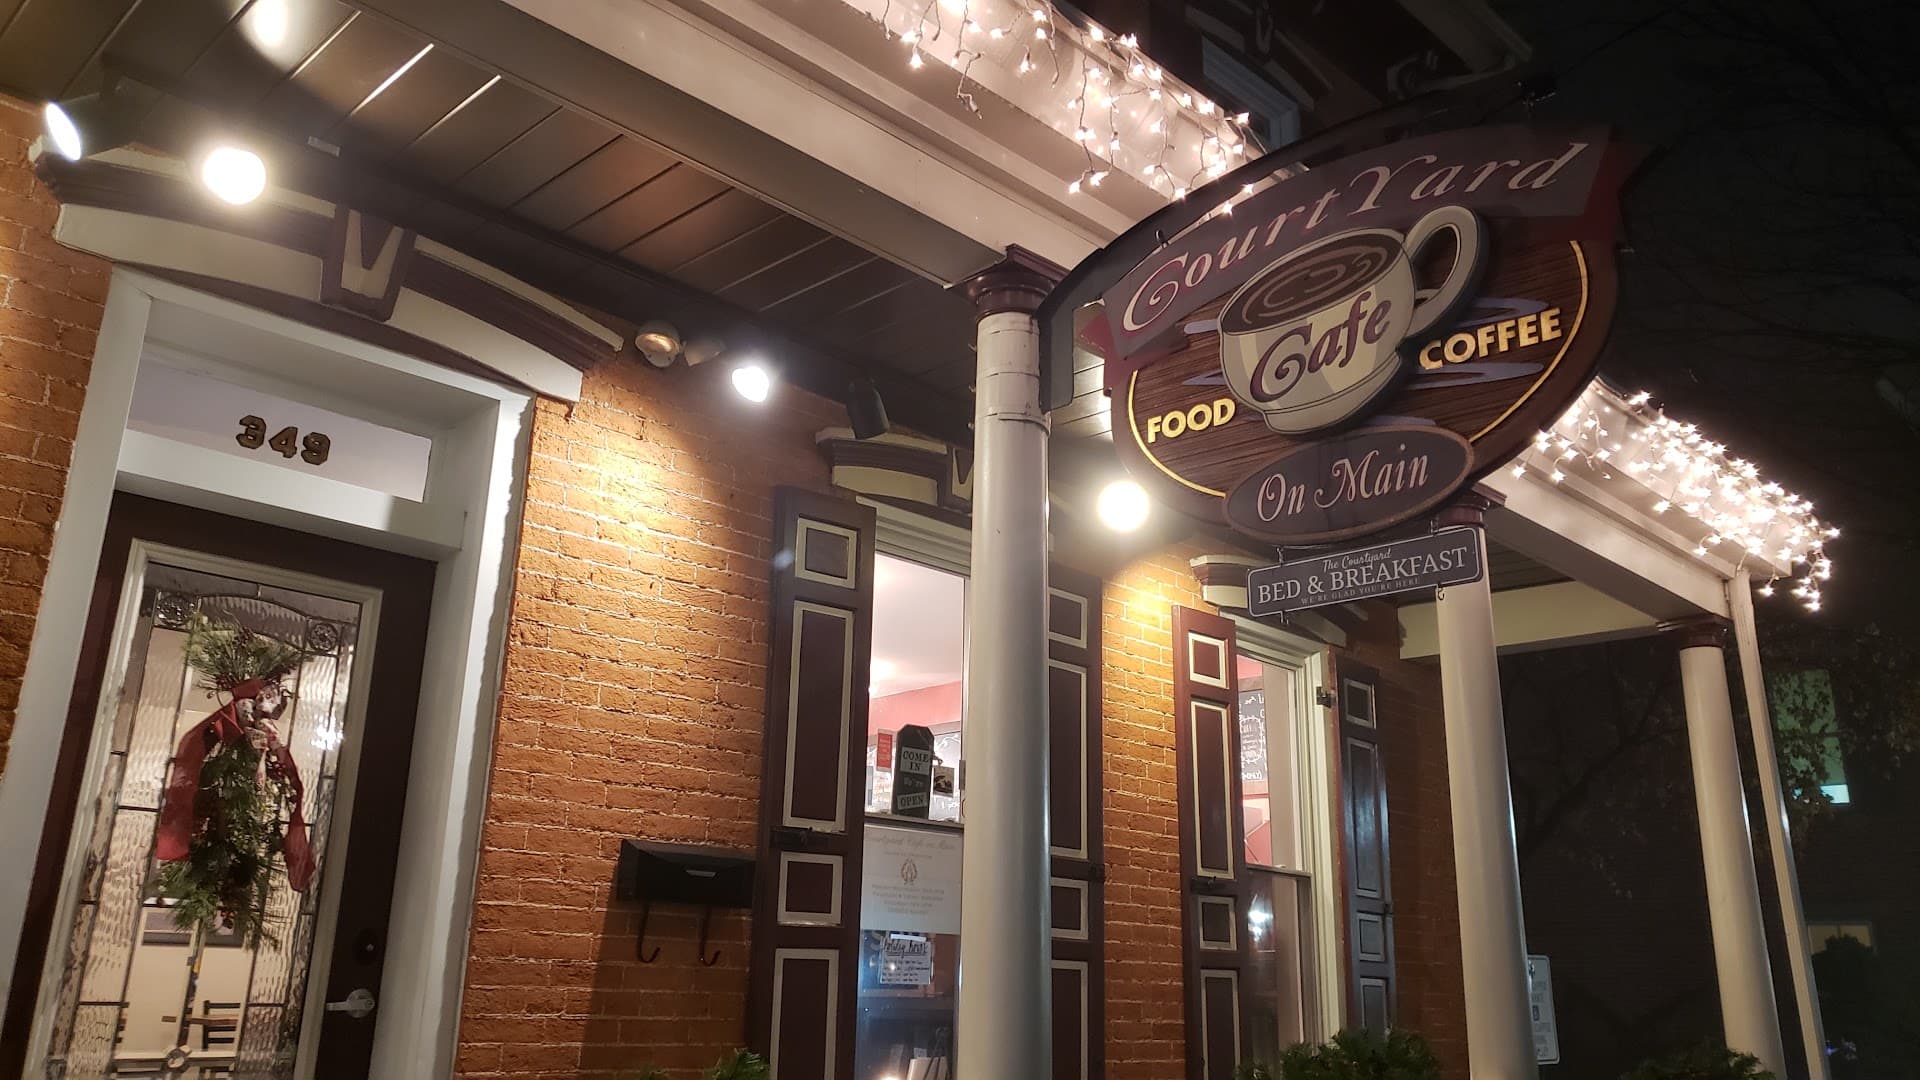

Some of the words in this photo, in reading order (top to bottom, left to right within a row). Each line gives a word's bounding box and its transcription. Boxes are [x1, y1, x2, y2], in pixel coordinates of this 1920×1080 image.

[1121, 187, 1342, 334] Court
[1346, 142, 1588, 216] Yard
[1250, 291, 1390, 402] Cafe
[1420, 309, 1562, 369] COFFEE
[235, 414, 331, 466] 349
[1147, 398, 1236, 443] FOOD
[1257, 474, 1305, 522] On
[1313, 444, 1428, 508] Main
[1257, 579, 1301, 604] BED
[1307, 575, 1325, 595] &
[1331, 547, 1467, 590] BREAKFAST
[1322, 559, 1339, 573] The
[1341, 547, 1392, 570] Courtyard
[902, 750, 929, 763] COME
[909, 761, 921, 772] IN
